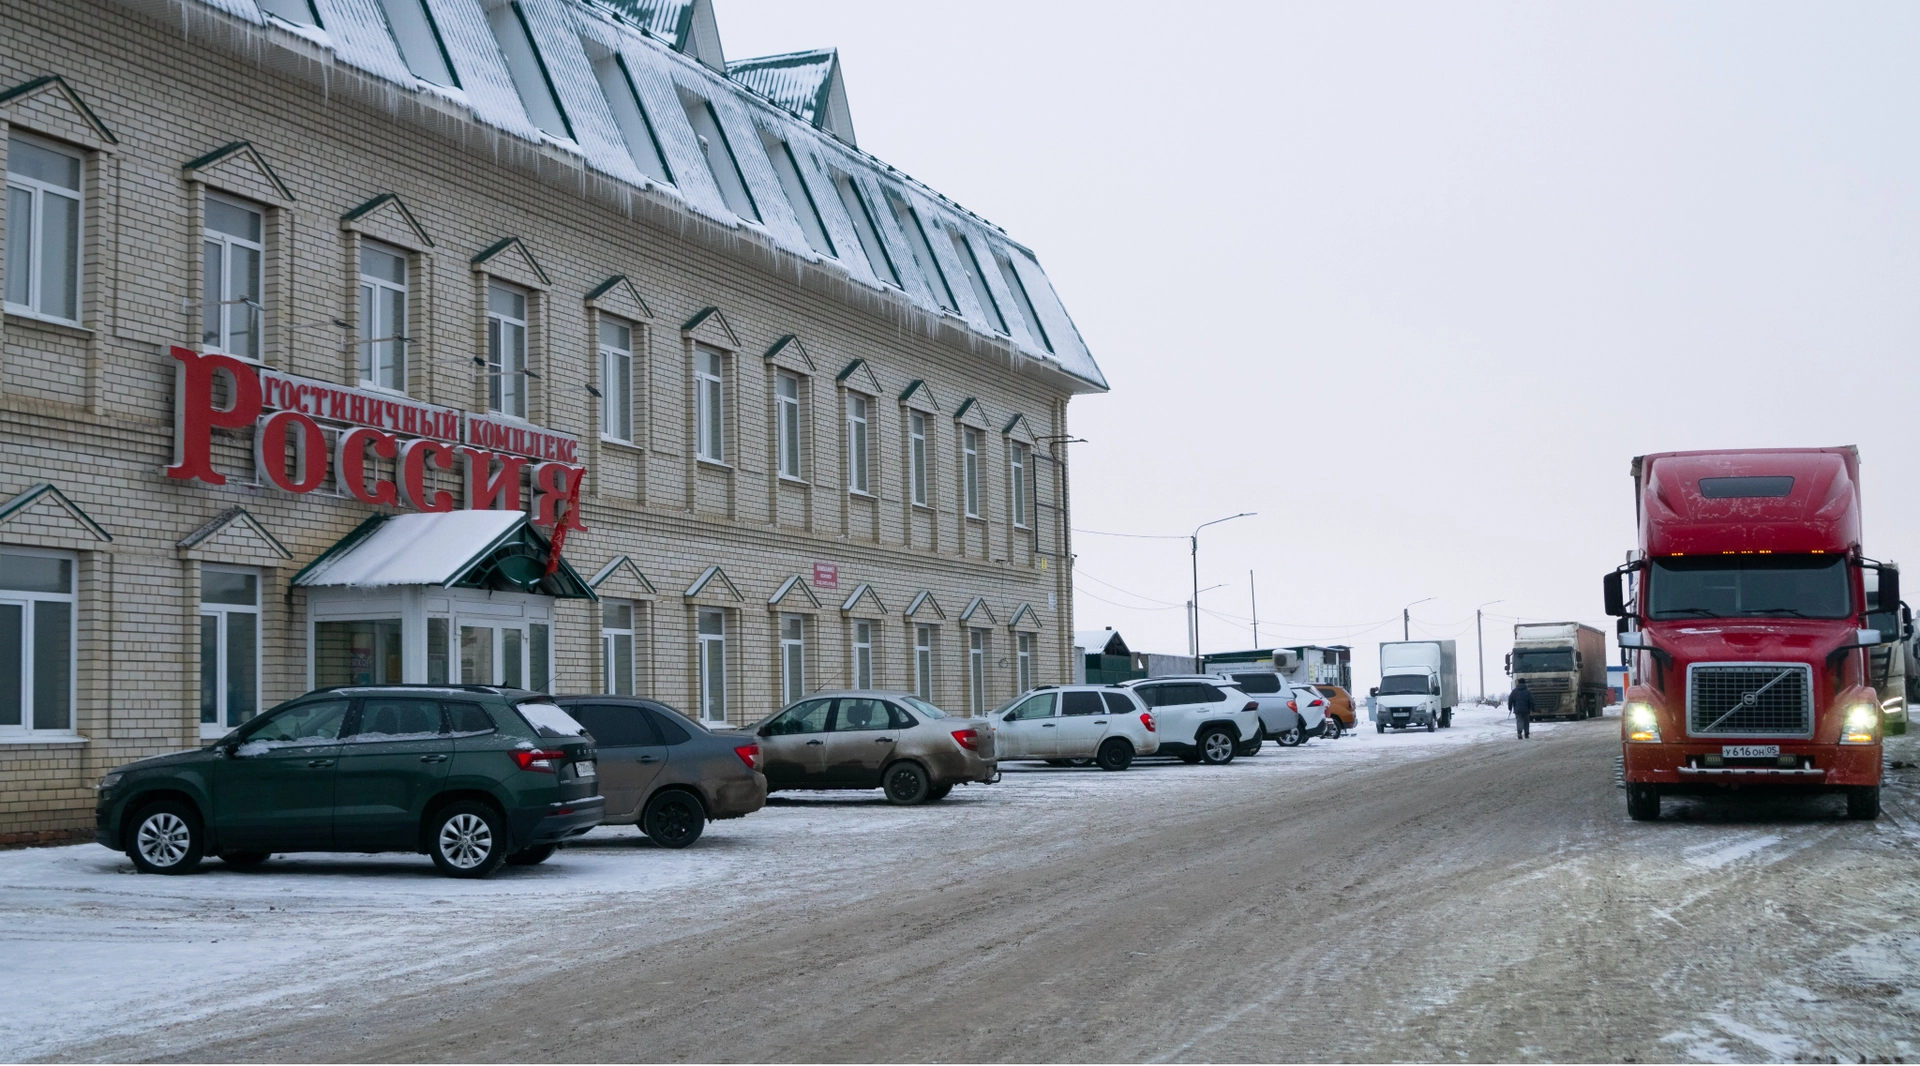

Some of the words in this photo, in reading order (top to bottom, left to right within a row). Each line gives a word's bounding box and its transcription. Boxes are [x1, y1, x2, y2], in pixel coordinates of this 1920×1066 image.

[263, 373, 459, 442] ГОСТИНИЧНЫЙ
[469, 417, 578, 464] КОМПЛЕКС
[1766, 746, 1777, 754] 05
